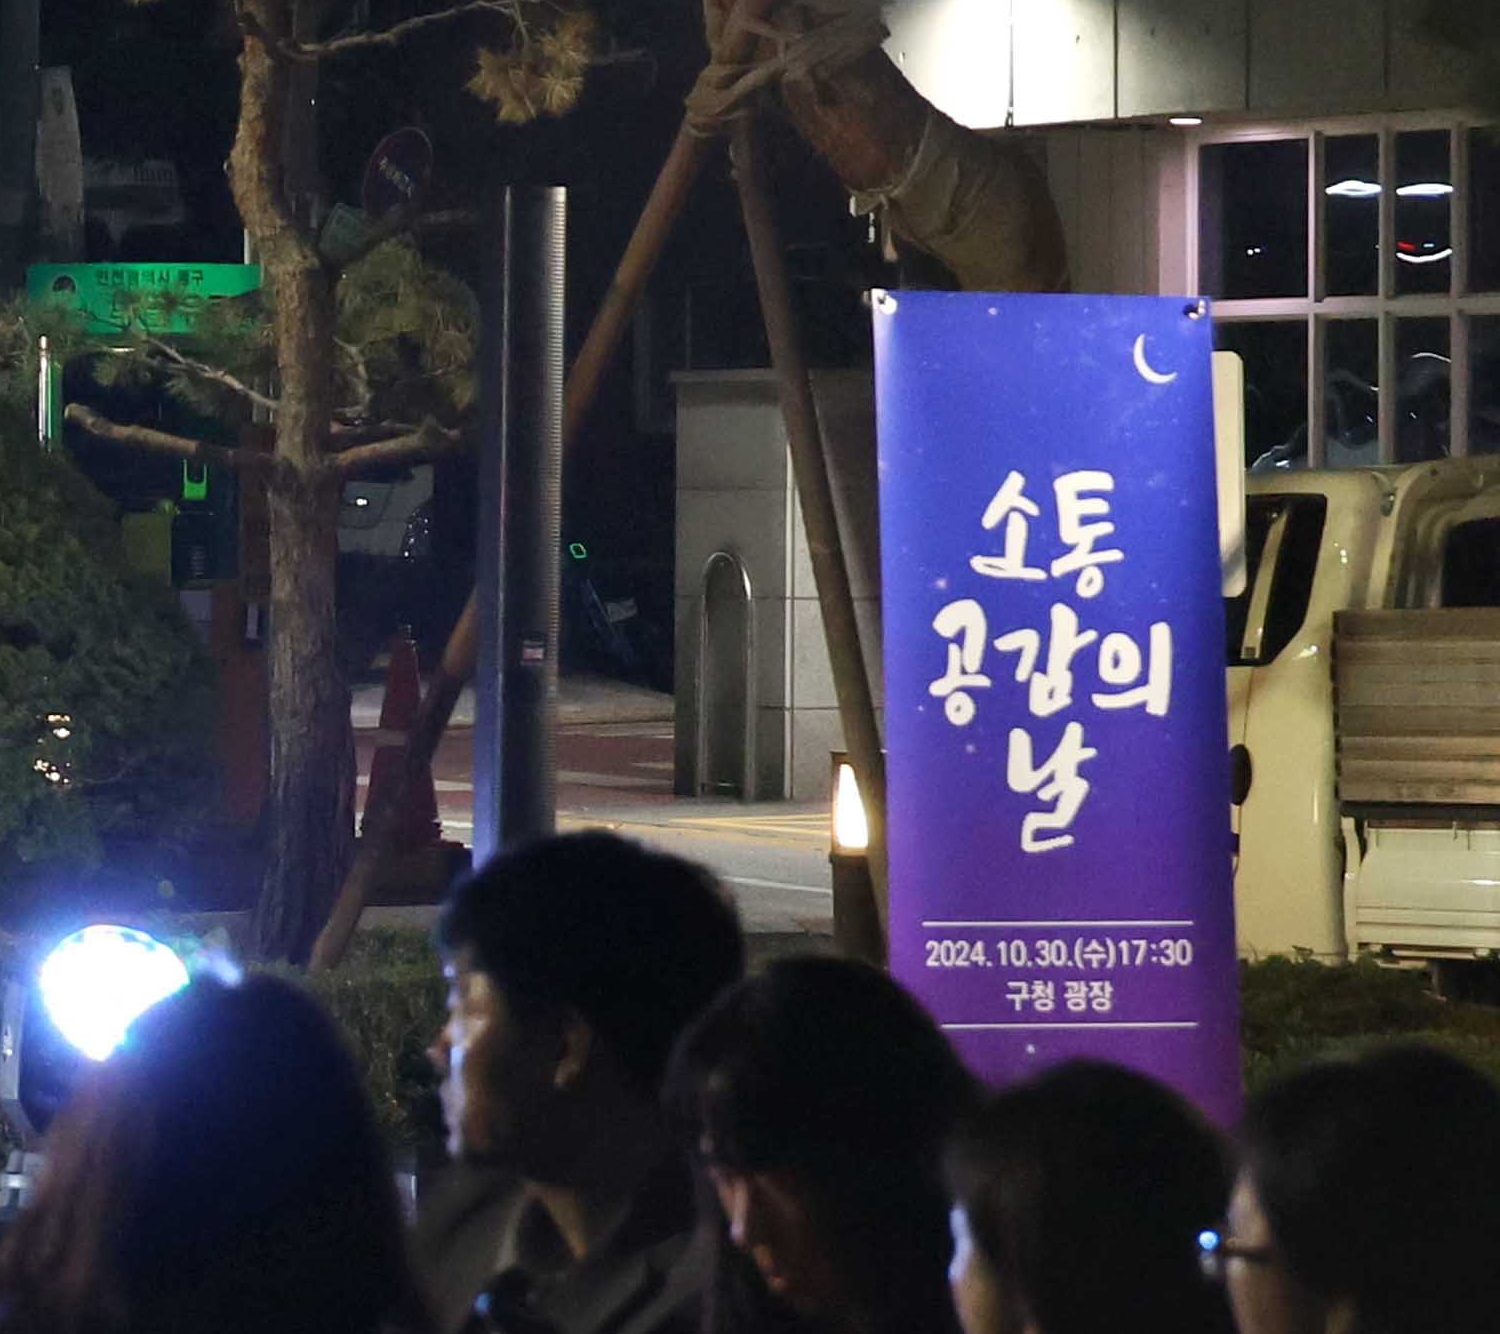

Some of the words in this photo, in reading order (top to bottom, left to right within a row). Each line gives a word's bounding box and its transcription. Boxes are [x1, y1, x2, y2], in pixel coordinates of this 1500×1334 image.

[970, 470, 1125, 599] 소통
[928, 599, 1172, 726] 공감의
[1007, 721, 1098, 853] 날
[1006, 980, 1054, 1011] 구청
[1064, 980, 1113, 1011] 광장
